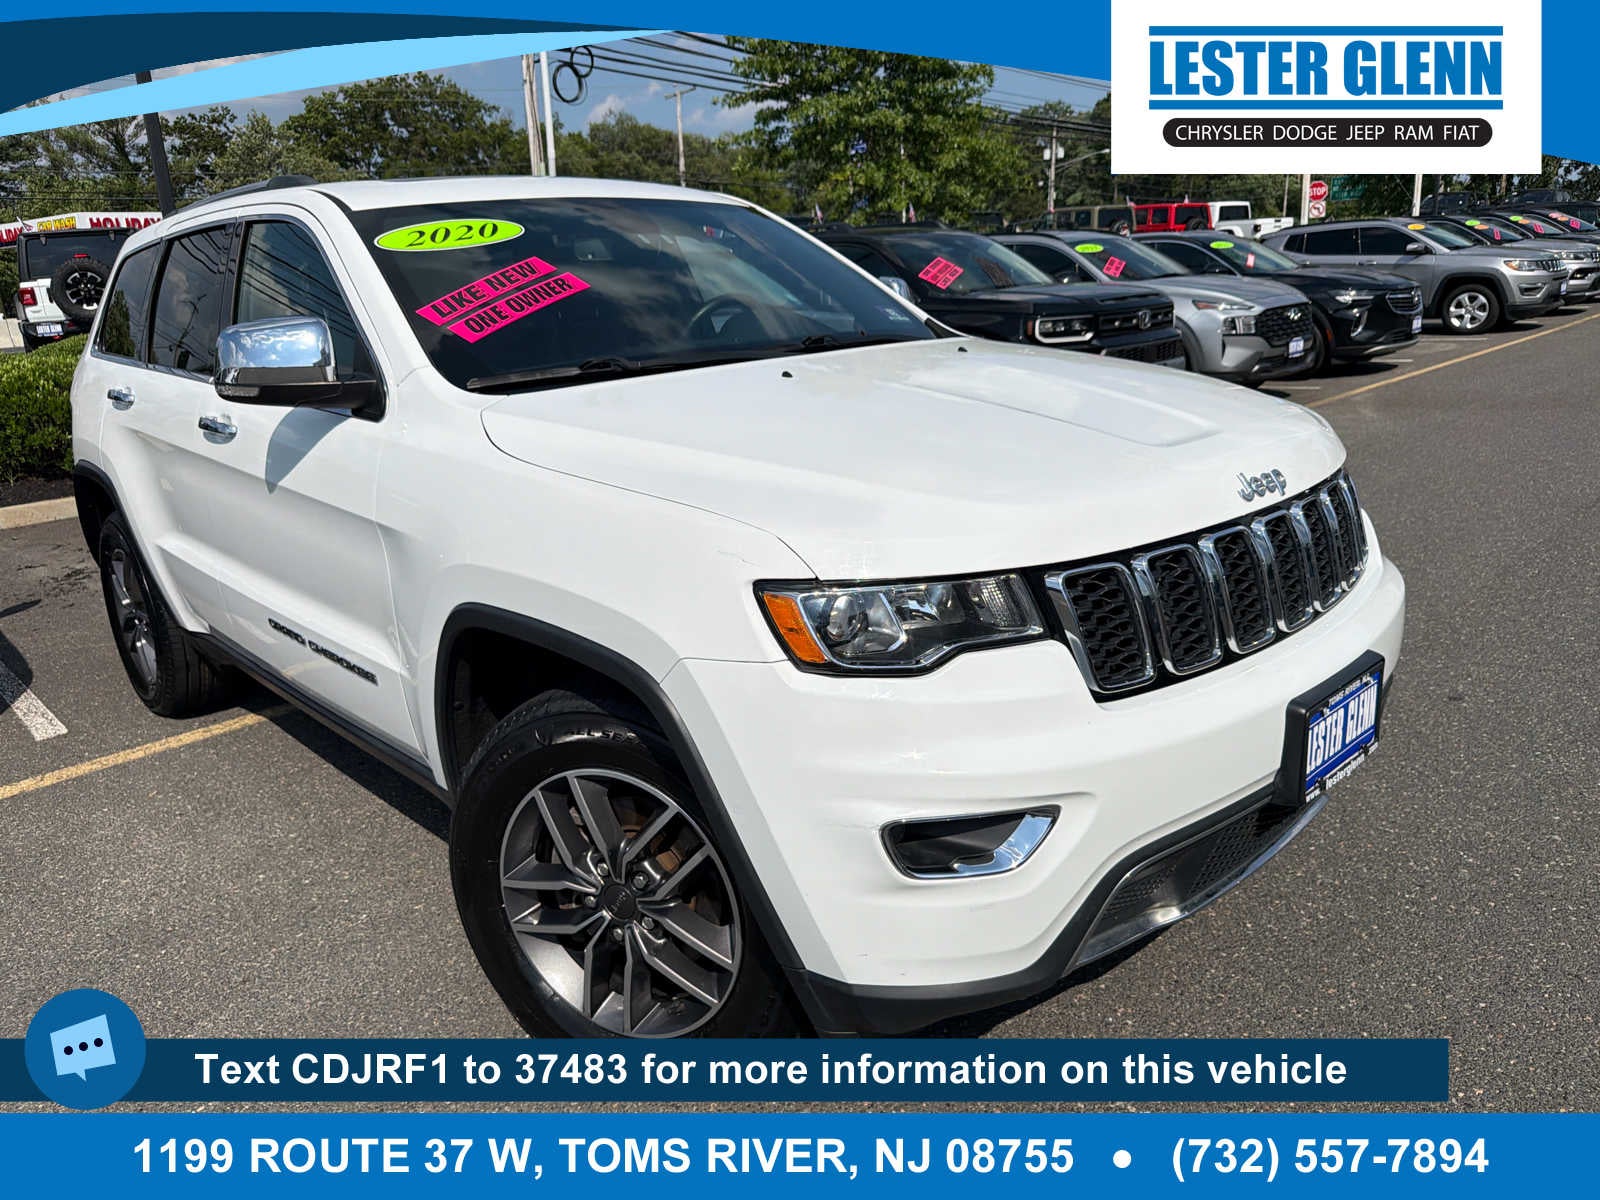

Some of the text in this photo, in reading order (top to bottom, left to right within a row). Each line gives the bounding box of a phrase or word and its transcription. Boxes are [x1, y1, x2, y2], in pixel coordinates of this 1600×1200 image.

[53, 216, 76, 231] WASH
[405, 222, 499, 248] 2020
[430, 261, 538, 319] LIKE NEW
[463, 277, 574, 335] ONE OWNER
[1236, 468, 1287, 502] Jeep
[268, 618, 379, 687] GRAND CHEROKEE
[1305, 683, 1378, 775] LESTER GLENN
